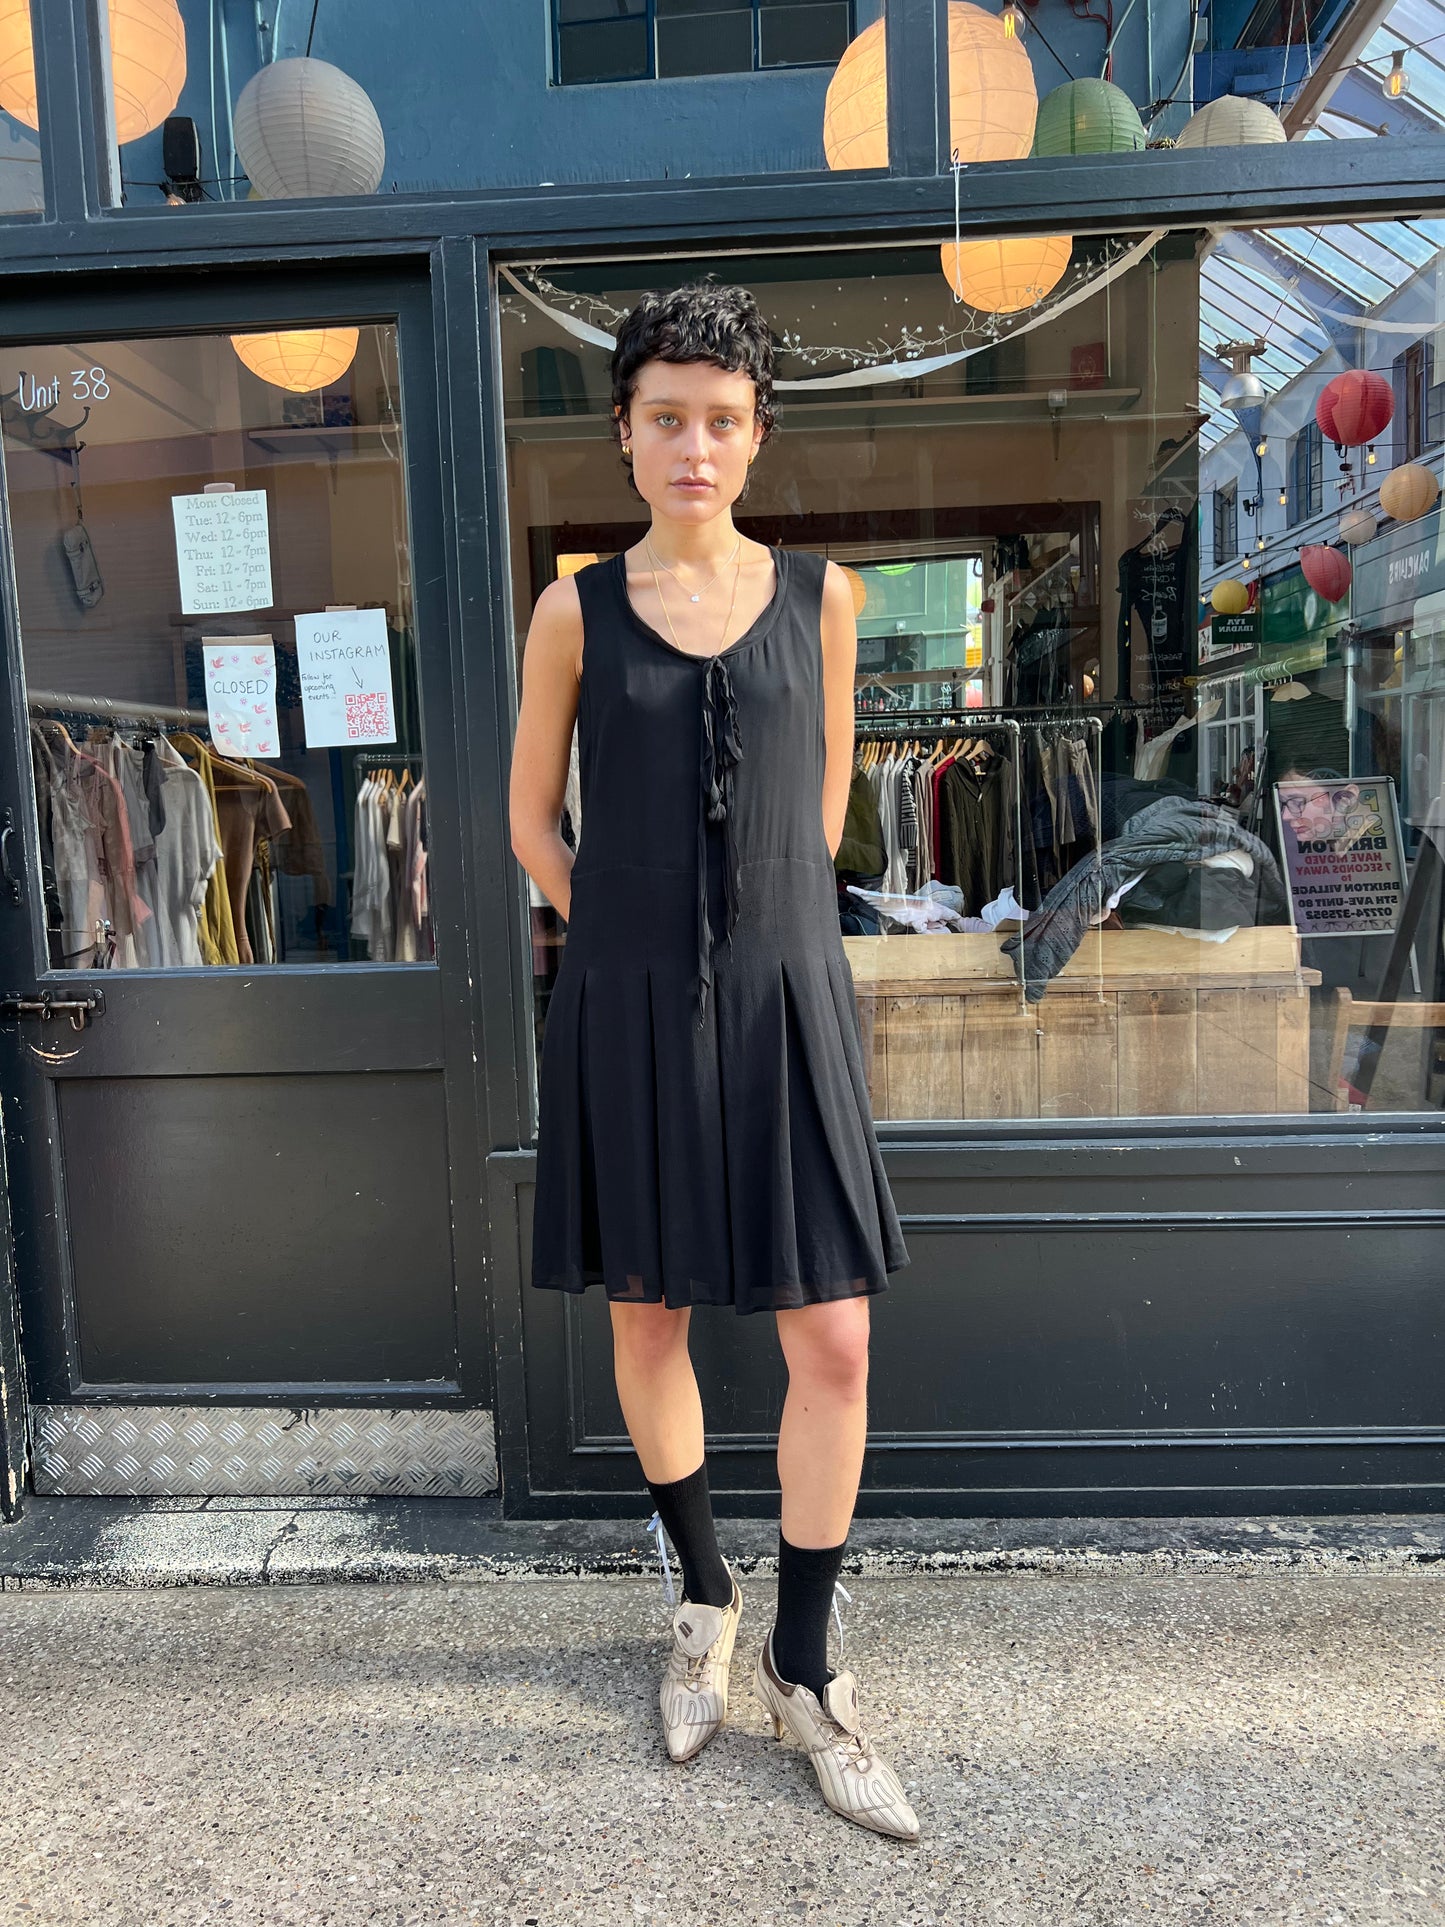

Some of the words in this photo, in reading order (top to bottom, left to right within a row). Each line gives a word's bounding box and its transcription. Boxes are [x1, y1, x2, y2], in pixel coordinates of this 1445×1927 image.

[19, 374, 60, 411] Unit
[70, 366, 110, 400] 38
[187, 499, 217, 509] Mon:
[221, 493, 259, 507] Closed
[186, 516, 212, 526] Tue:
[185, 532, 217, 542] Wed:
[184, 549, 213, 560] Thu:
[196, 566, 215, 576] Fri:
[197, 583, 218, 593] Sat:
[193, 599, 220, 610] Sun:
[313, 630, 341, 644] OUR
[309, 644, 386, 661] INSTAGRAM
[213, 679, 268, 695] CLOSED
[304, 683, 336, 695] upcoming
